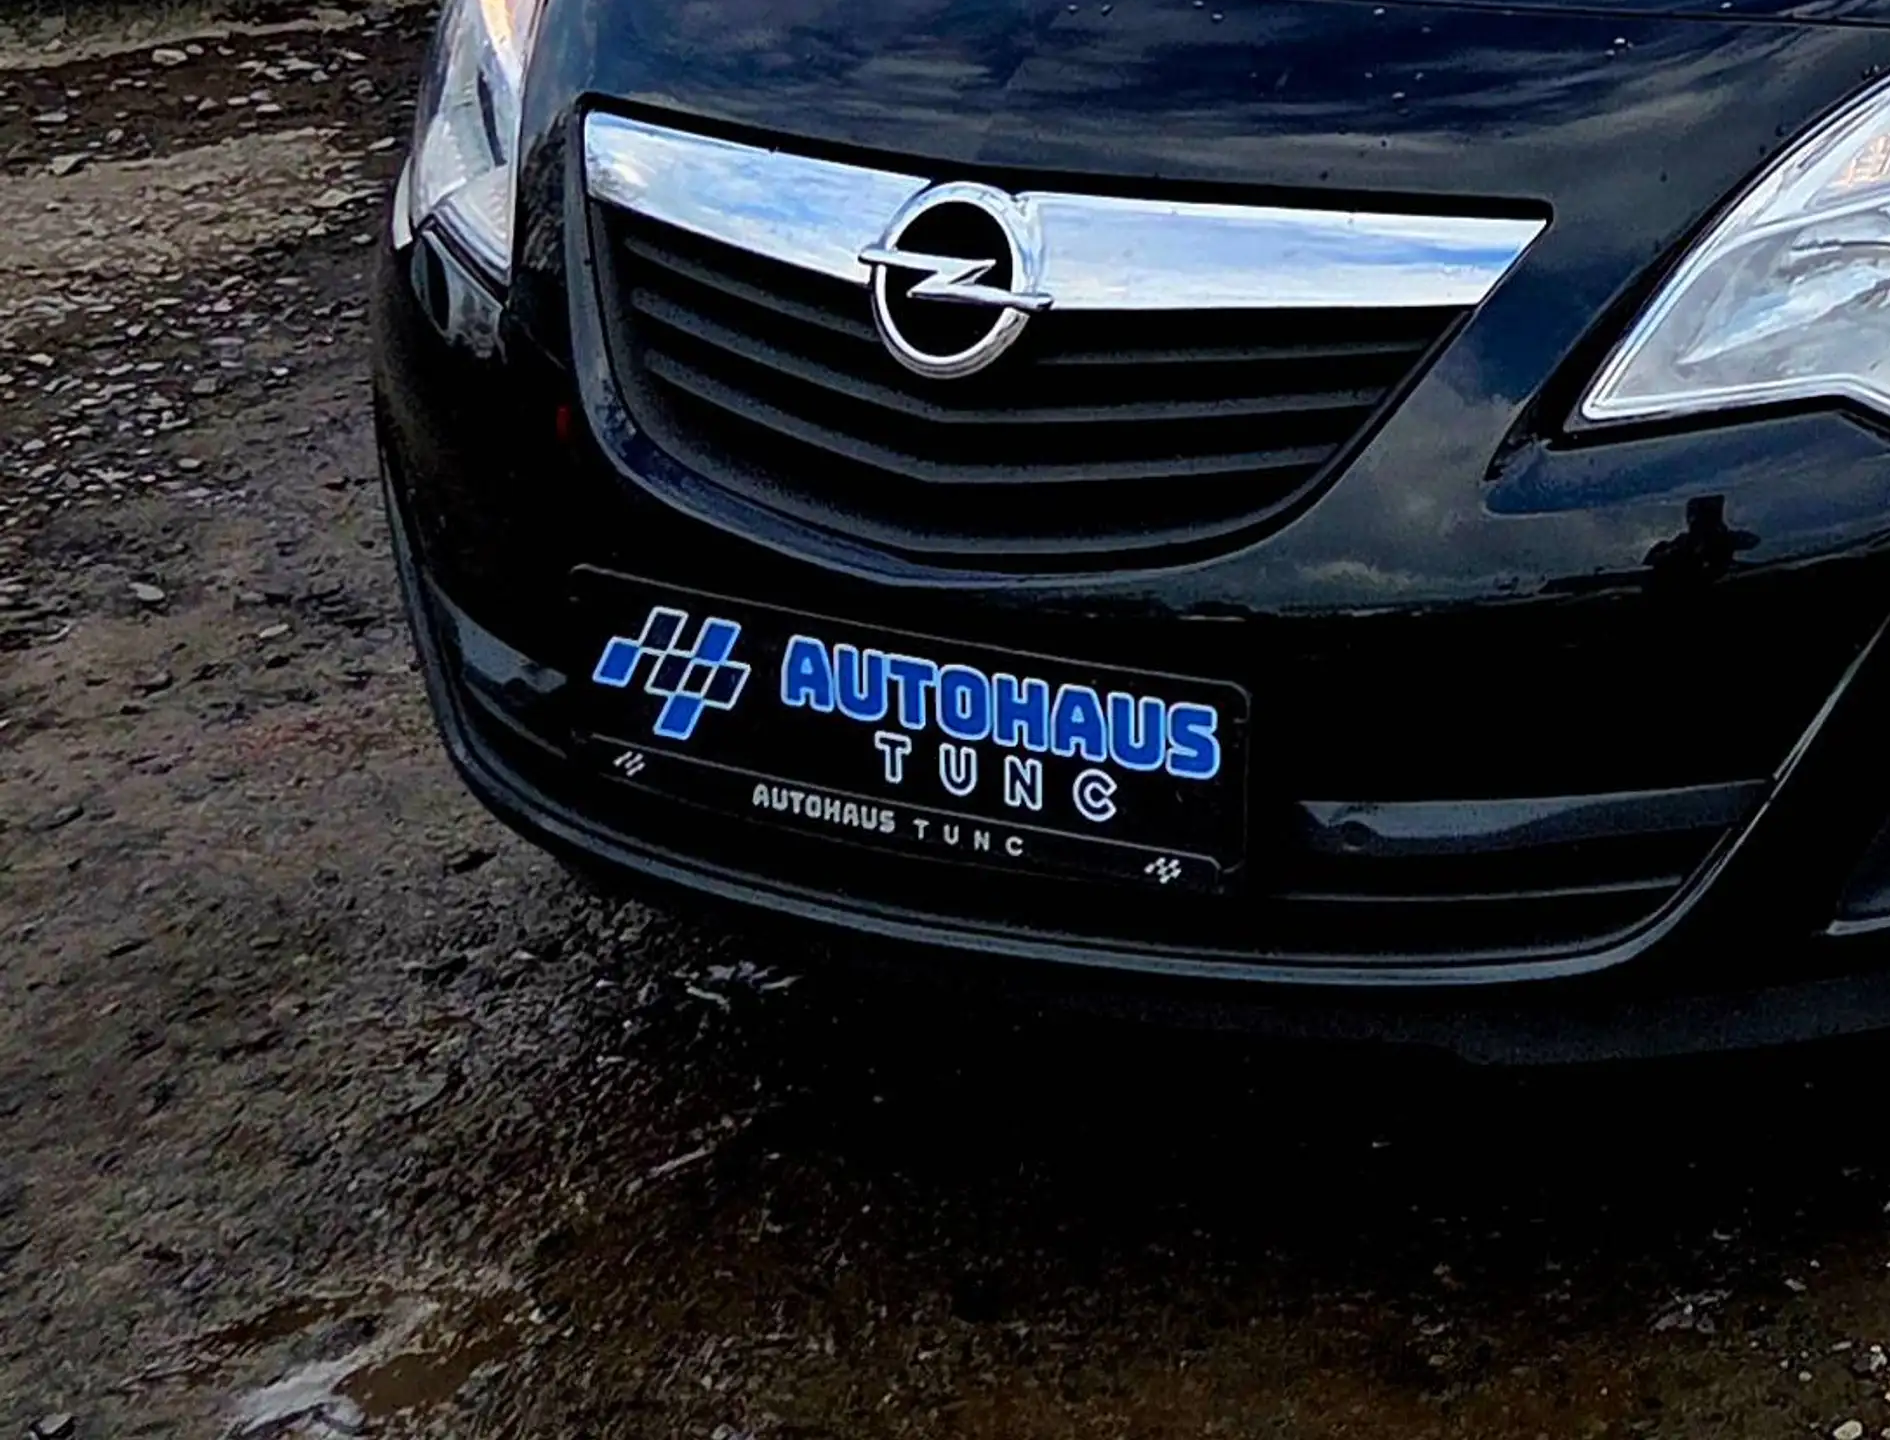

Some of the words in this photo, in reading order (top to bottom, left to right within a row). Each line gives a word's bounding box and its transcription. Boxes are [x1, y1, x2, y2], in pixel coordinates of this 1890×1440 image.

[780, 633, 1222, 781] AUTOHAUS
[752, 783, 896, 834] AUTOHAUS
[913, 818, 1024, 857] TUNC
[874, 730, 1118, 822] TUNC
